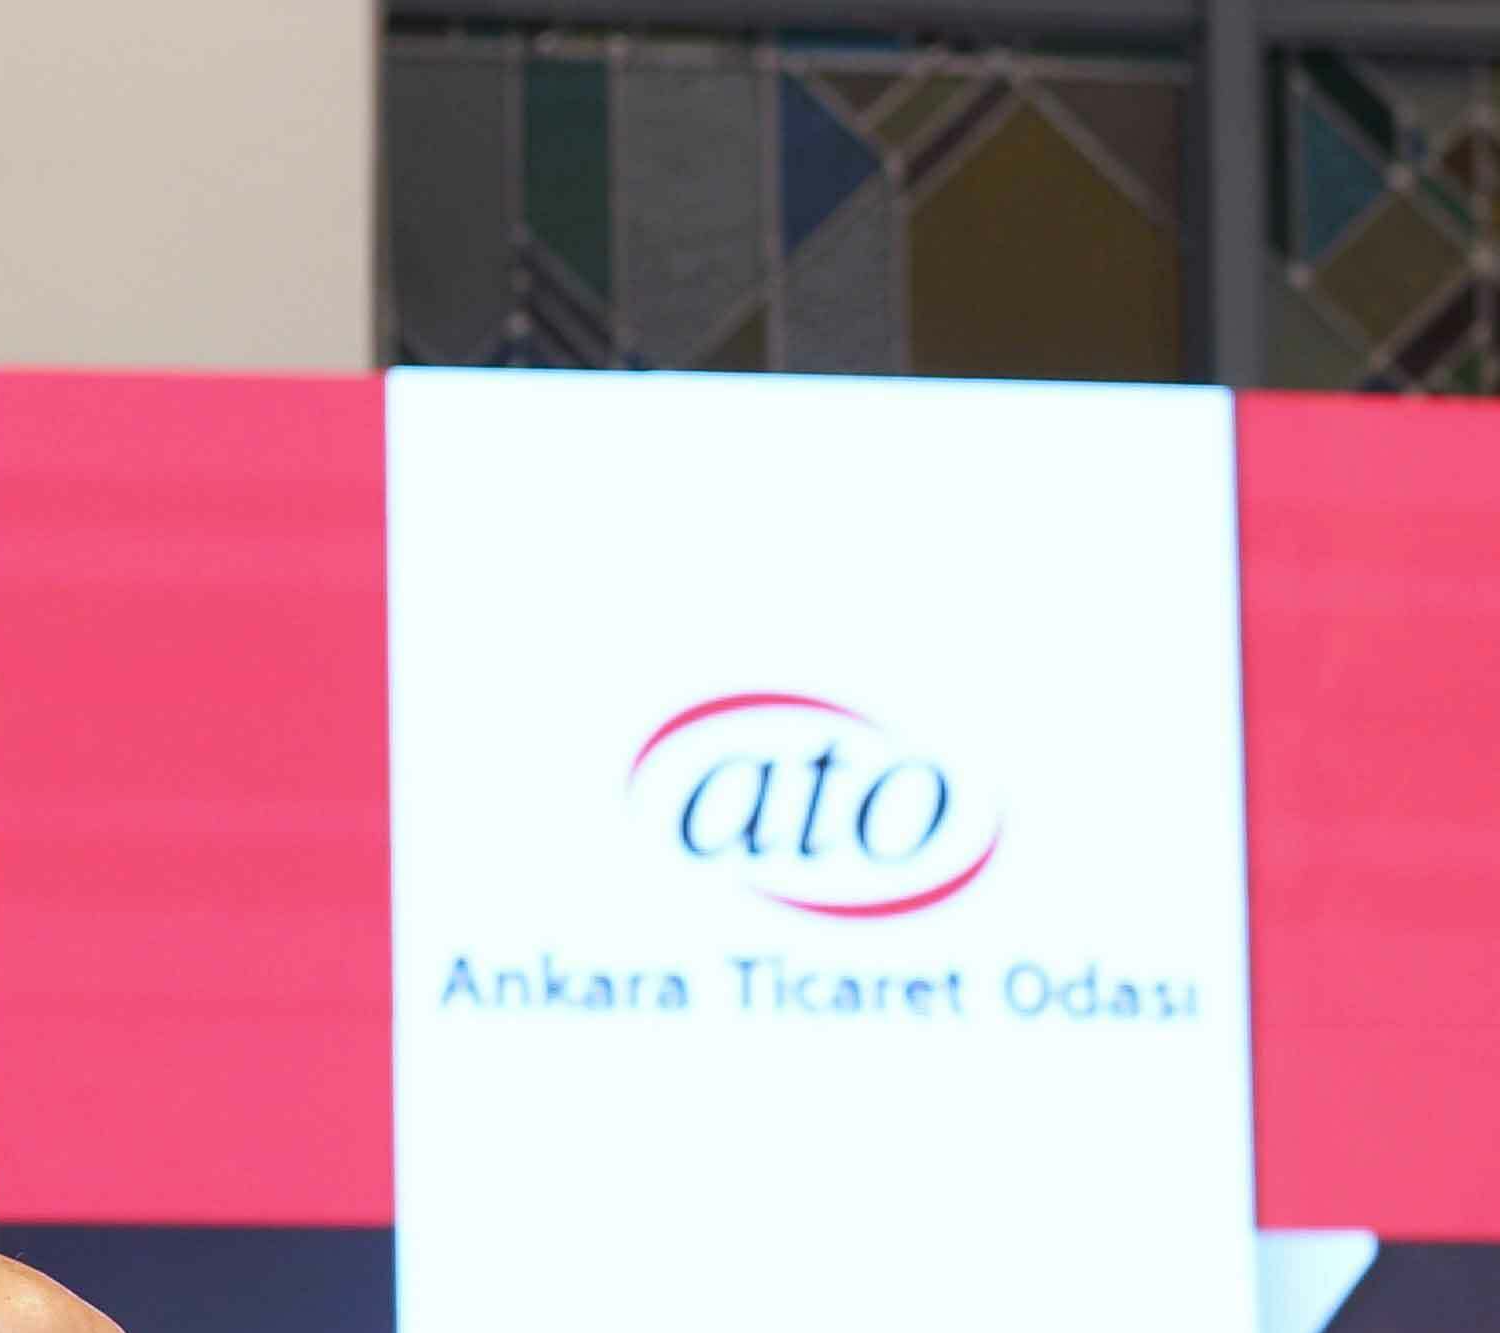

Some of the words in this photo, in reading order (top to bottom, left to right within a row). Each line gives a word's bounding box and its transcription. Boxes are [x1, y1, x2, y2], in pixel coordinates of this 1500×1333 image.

[673, 738, 955, 865] ato
[437, 951, 692, 1014] Ankara
[728, 953, 966, 1019] Ticaret
[1001, 960, 1199, 1023] Odası
